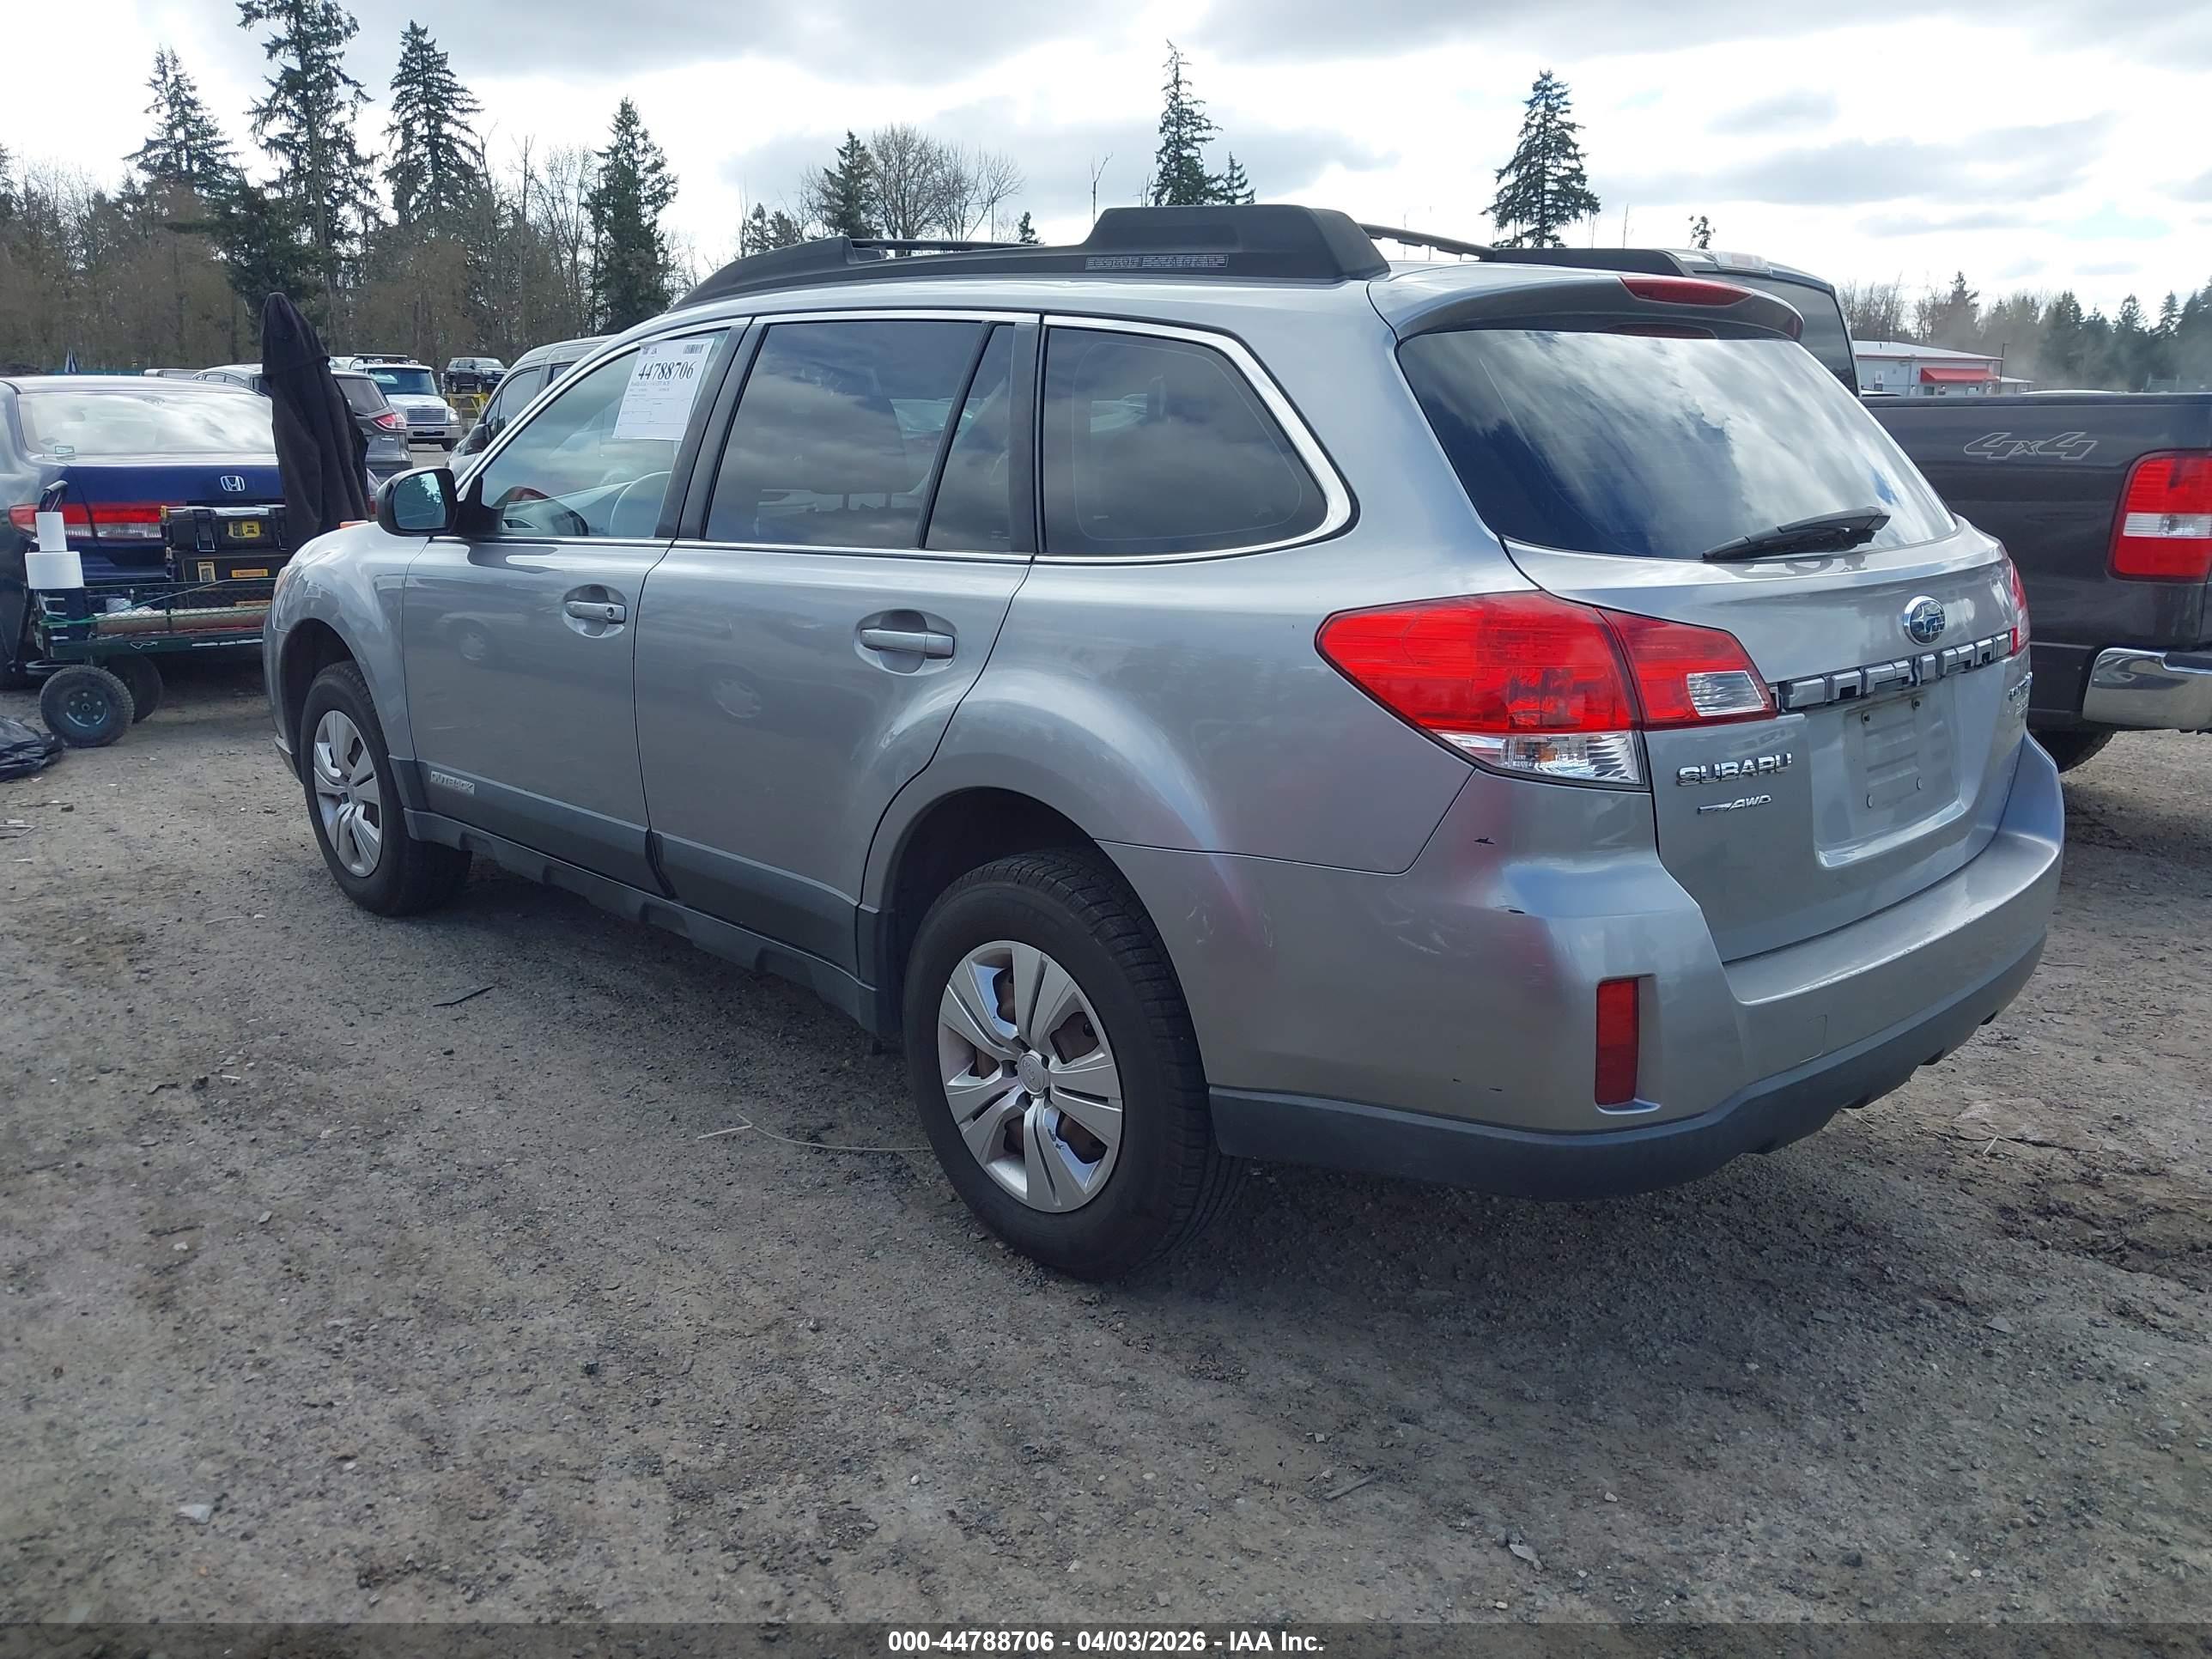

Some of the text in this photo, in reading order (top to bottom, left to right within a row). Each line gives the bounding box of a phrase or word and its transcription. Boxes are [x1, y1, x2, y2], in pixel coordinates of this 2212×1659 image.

[638, 361, 697, 380] 44788706
[1963, 432, 2099, 460] 4x4
[1676, 752, 1792, 787] SUBARU
[1728, 794, 1772, 811] AWD
